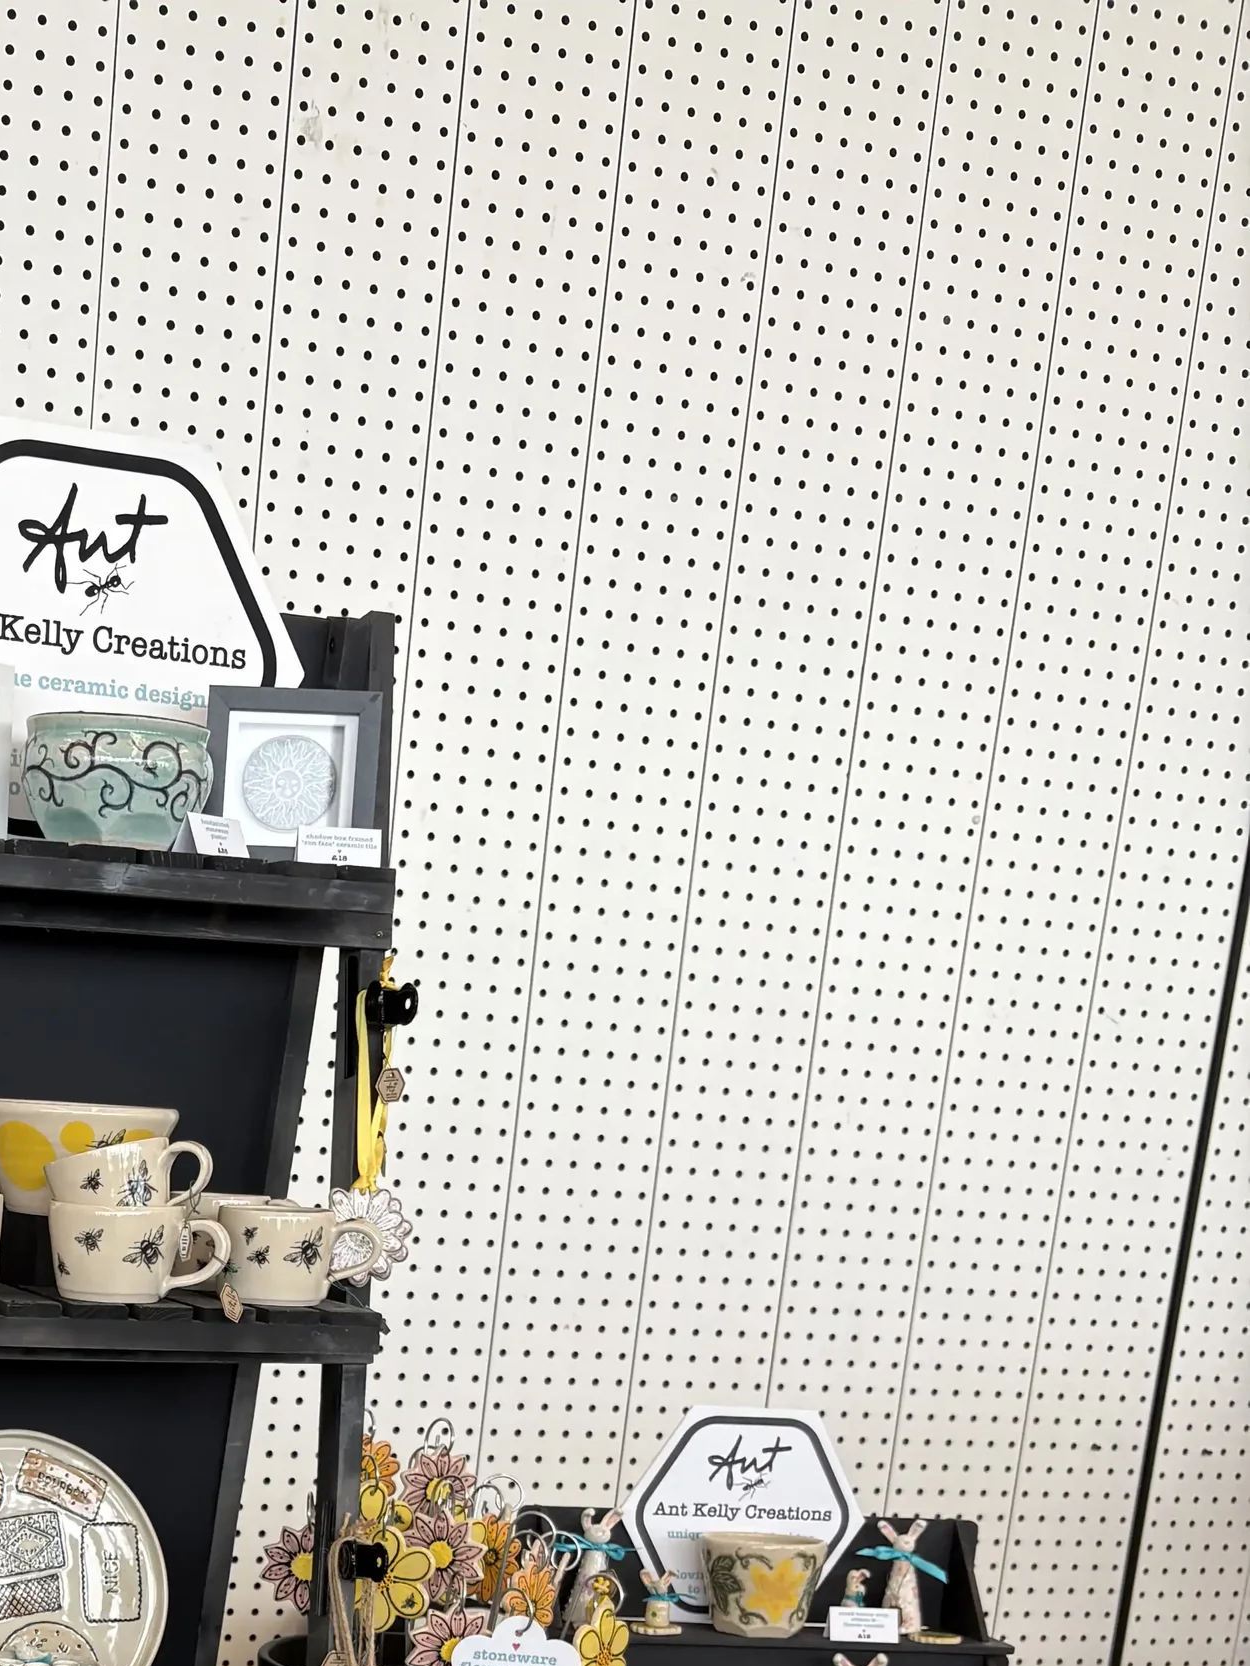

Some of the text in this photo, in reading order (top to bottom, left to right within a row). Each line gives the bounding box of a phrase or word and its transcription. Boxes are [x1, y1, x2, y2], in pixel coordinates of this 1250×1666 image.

[18, 483, 168, 594] Ant
[93, 625, 247, 669] Creations
[39, 673, 129, 698] ceramic
[135, 684, 207, 711] design
[708, 1434, 792, 1490] Ant
[37, 1472, 90, 1499] BOURBON
[653, 1502, 832, 1521] Ant Kelly Creations
[102, 1551, 120, 1595] NICE
[473, 1650, 557, 1666] stoneware
